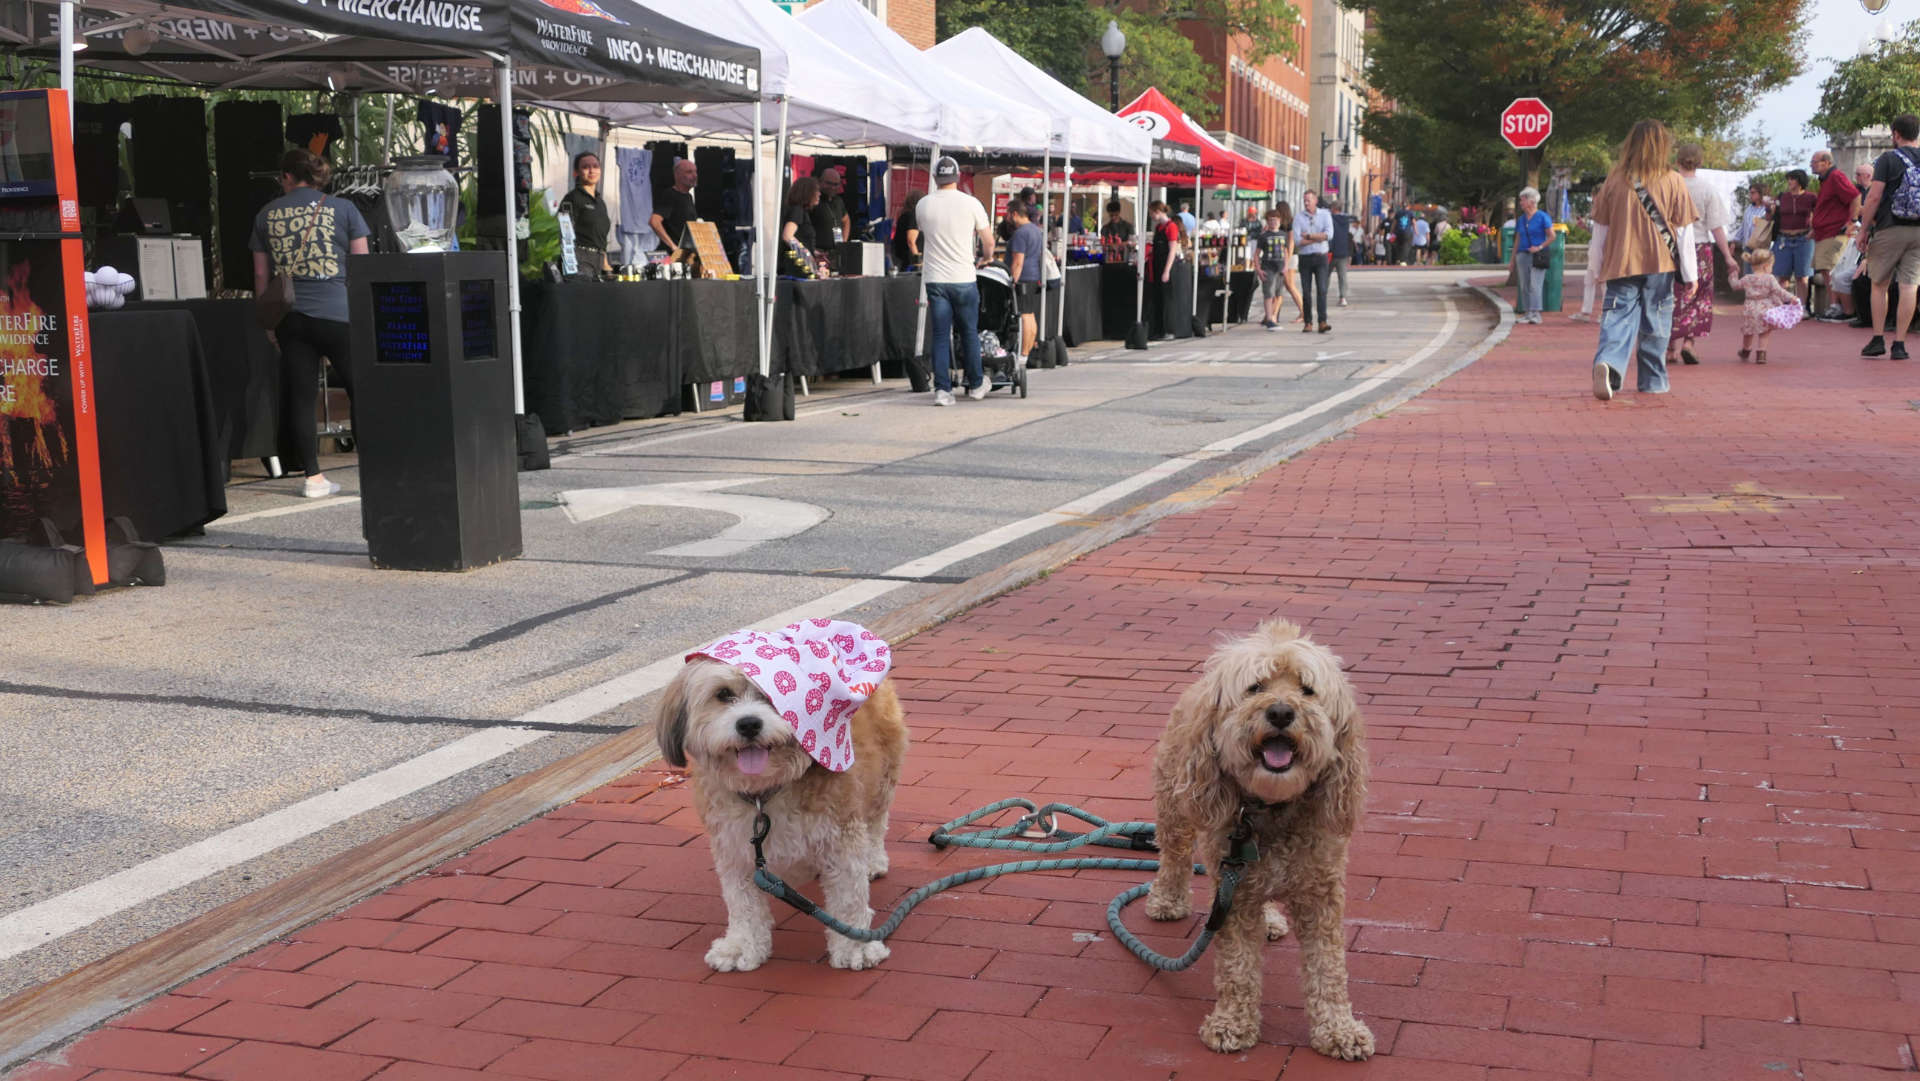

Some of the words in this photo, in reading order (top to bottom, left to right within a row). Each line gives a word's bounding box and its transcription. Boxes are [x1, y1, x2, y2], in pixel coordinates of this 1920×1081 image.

[536, 18, 594, 46] WATERFIRE
[541, 39, 588, 57] PROVIDENCE
[606, 37, 643, 64] INFO
[645, 47, 654, 65] +
[657, 46, 745, 86] MERCHANDISE
[1505, 113, 1548, 134] STOP
[266, 221, 287, 237] IS
[289, 213, 336, 232] ONE
[269, 235, 296, 252] OF
[271, 241, 338, 264] VITAL
